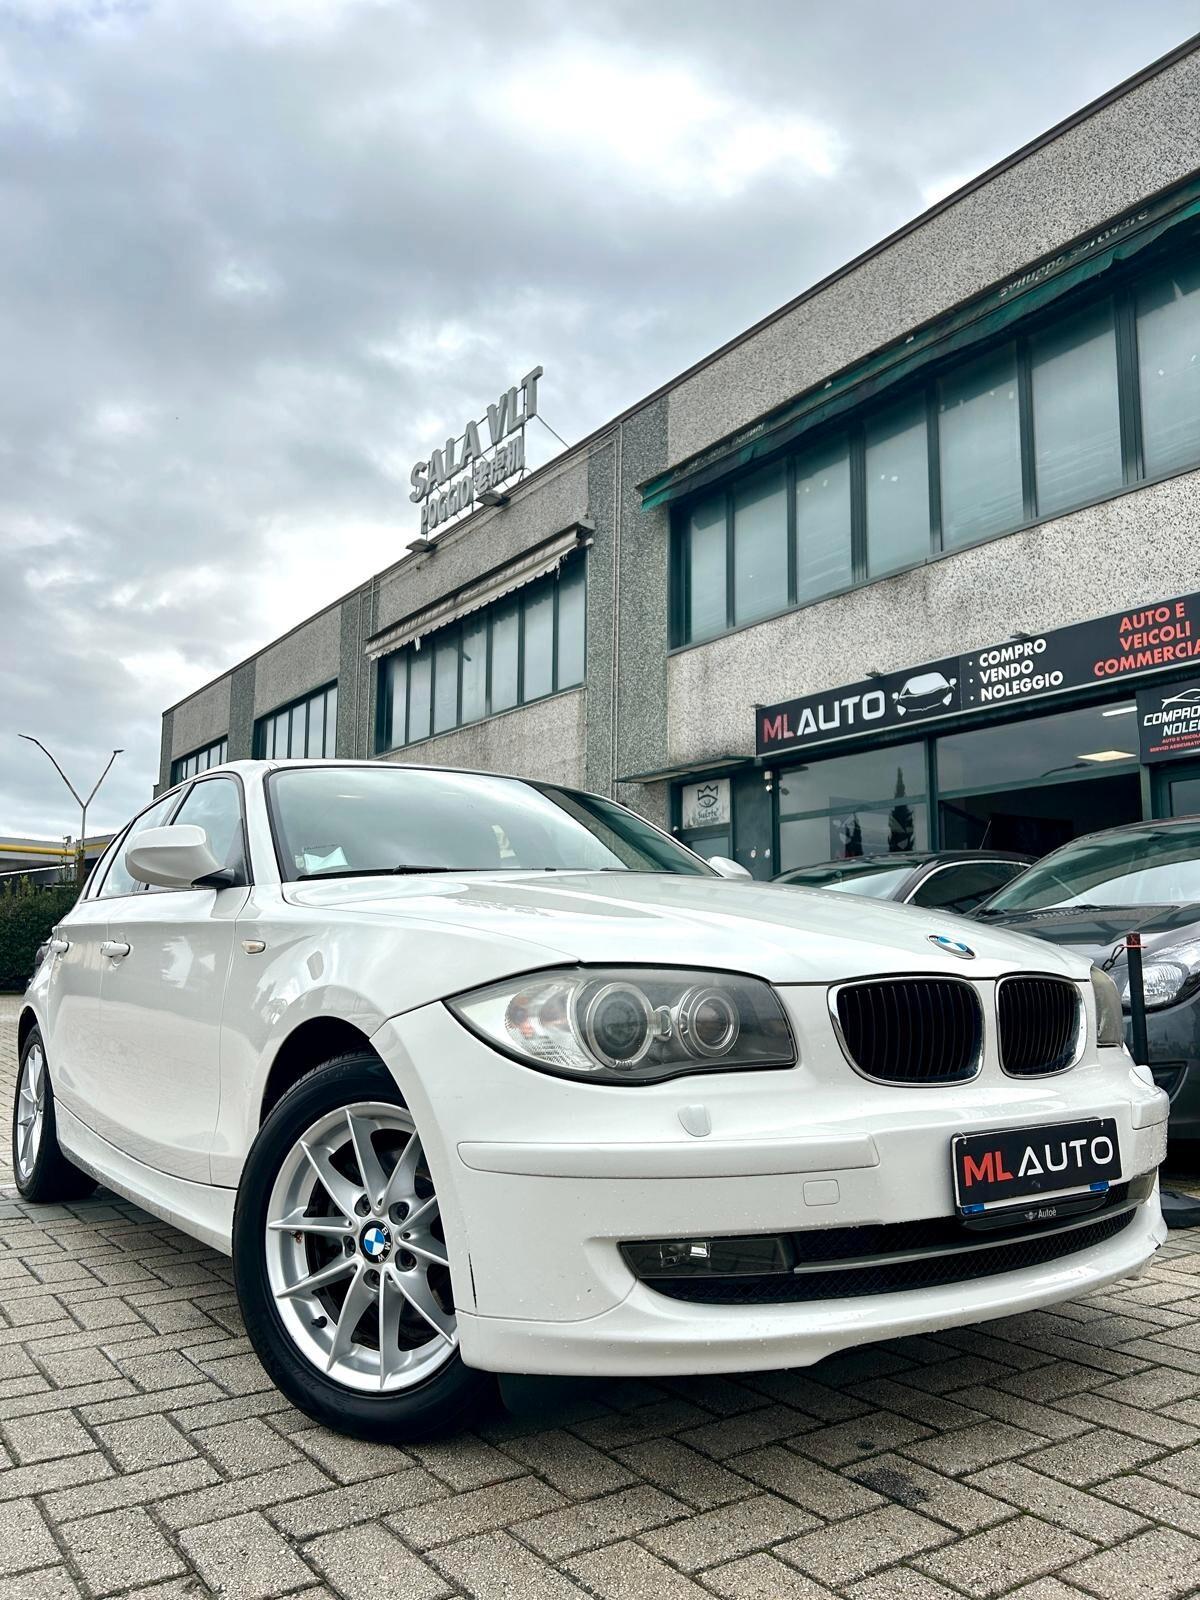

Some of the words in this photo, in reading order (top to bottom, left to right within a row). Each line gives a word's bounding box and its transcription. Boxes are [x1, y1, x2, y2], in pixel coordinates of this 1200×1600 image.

[409, 420, 481, 503] SALA
[487, 365, 543, 446] VLT
[421, 475, 474, 535] POGGIO
[1120, 606, 1171, 634] AUTO
[1175, 602, 1185, 618] E
[1120, 620, 1191, 651] VEICOLI
[979, 638, 1047, 667] COMPRO
[979, 659, 1034, 684] VENDO
[980, 670, 1064, 702] NOLEGGIO
[763, 713, 795, 743] ML
[796, 690, 886, 737] AUTO
[1162, 719, 1200, 737] NOLE
[963, 1151, 1014, 1187] ML
[1017, 1136, 1114, 1178] AUTO
